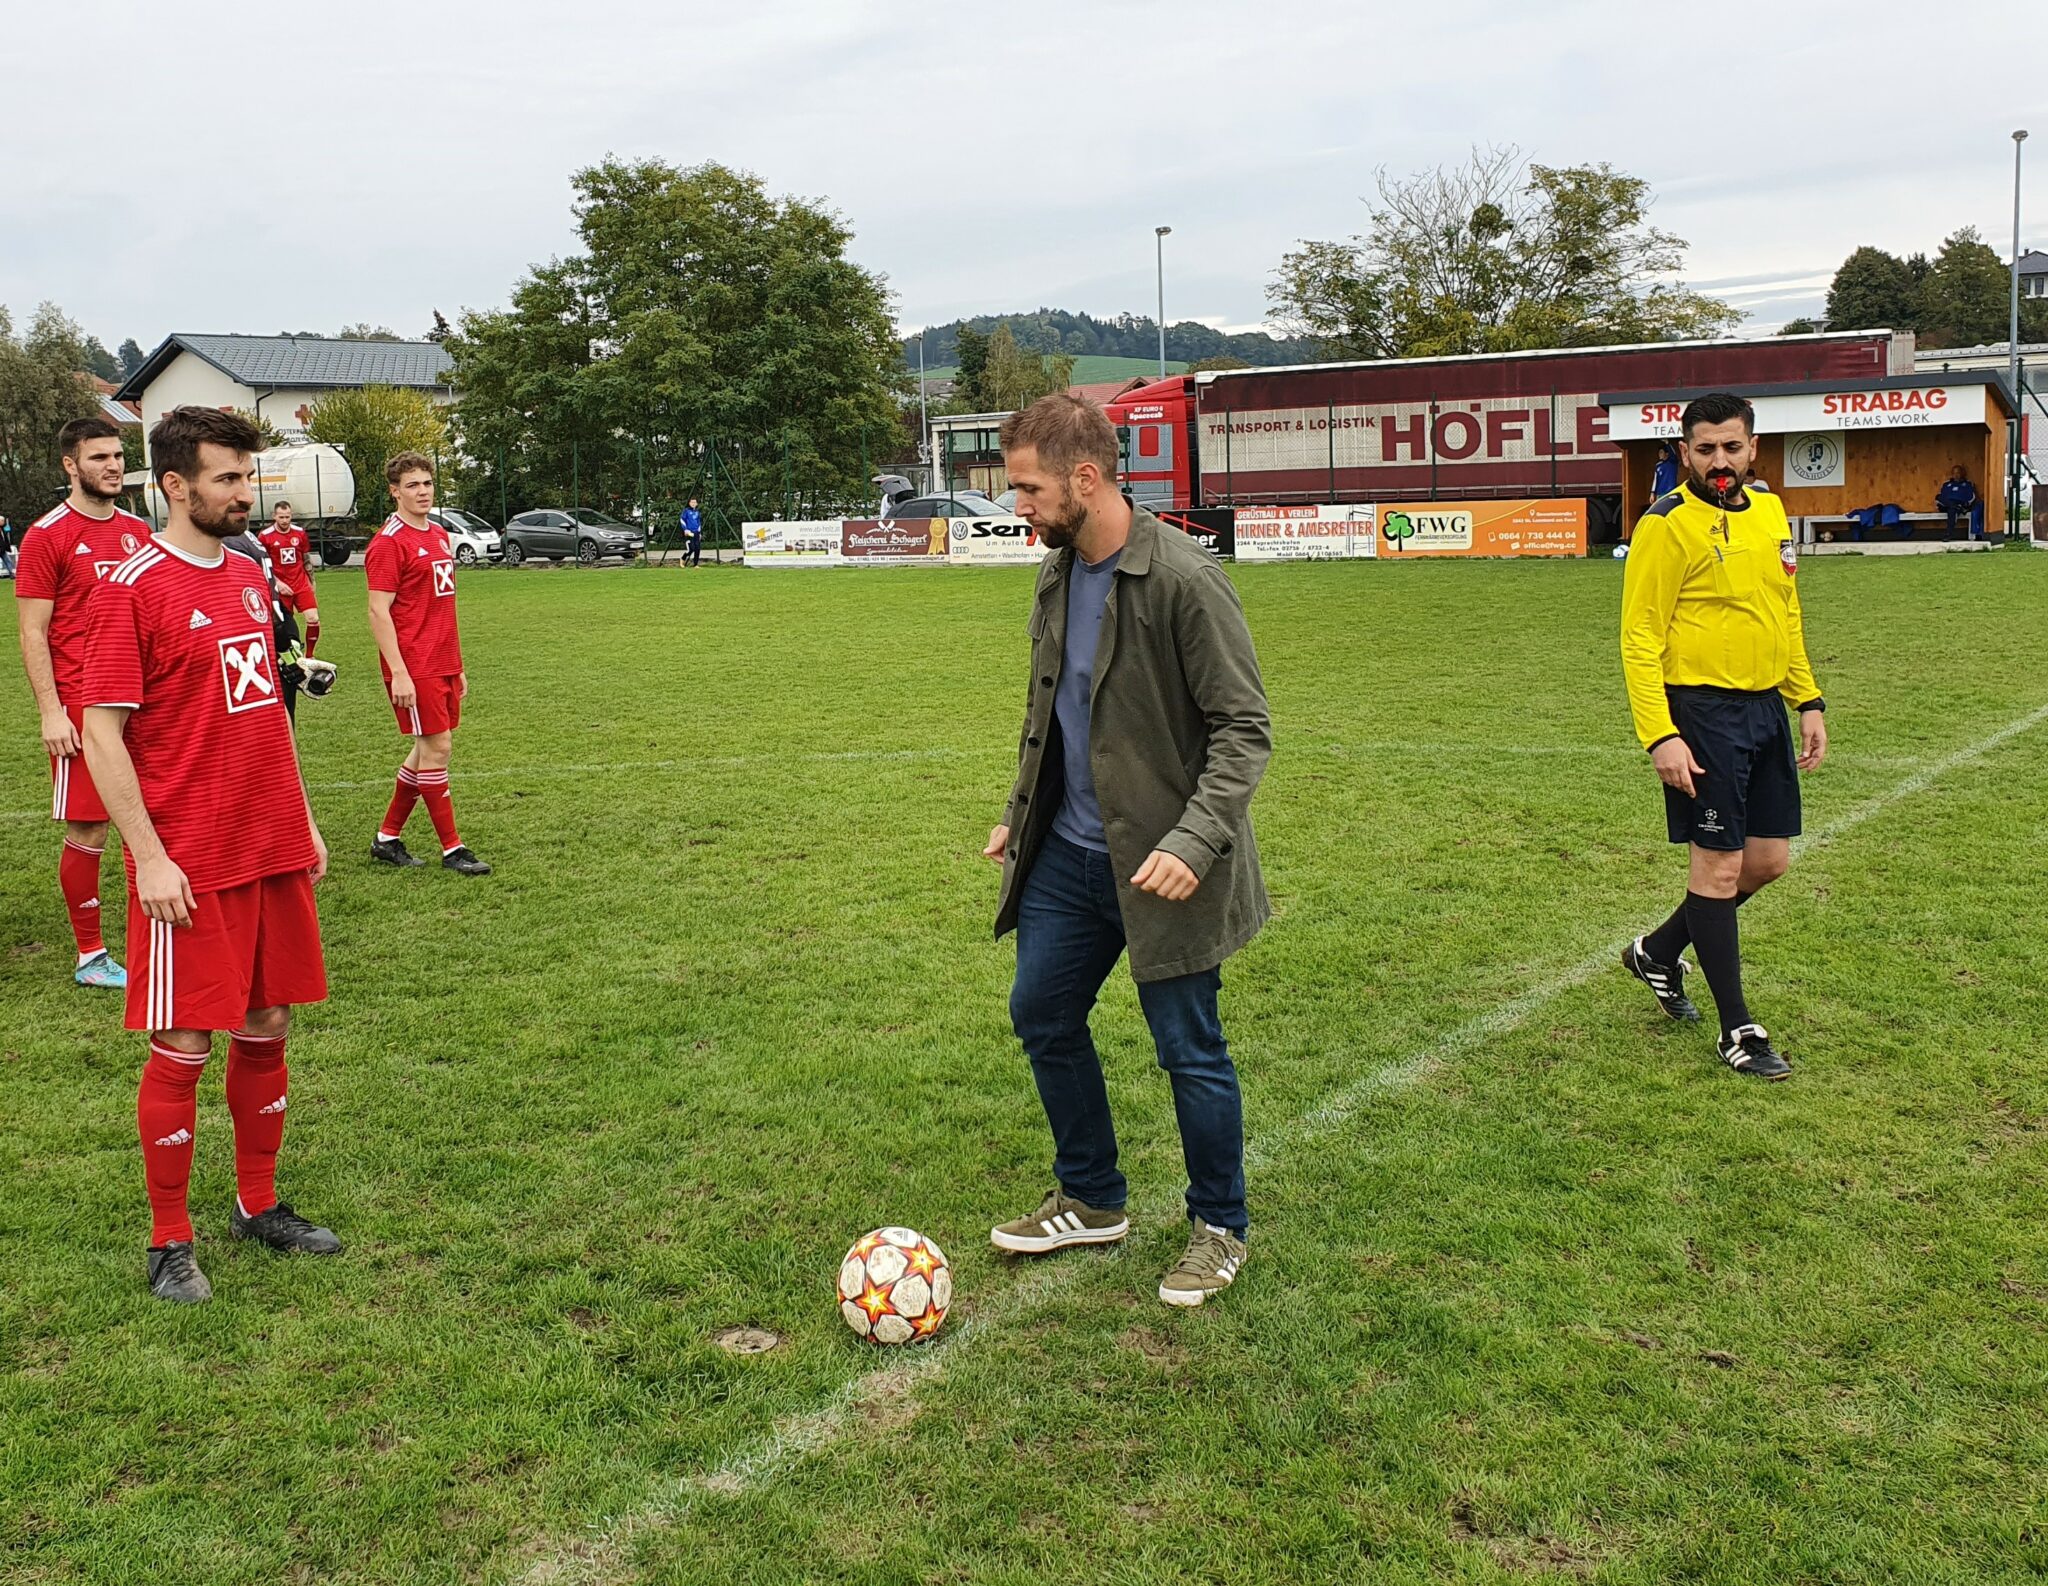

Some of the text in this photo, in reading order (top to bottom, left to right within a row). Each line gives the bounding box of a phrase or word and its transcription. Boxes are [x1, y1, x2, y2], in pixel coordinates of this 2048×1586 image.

[1823, 388, 1948, 415] STRABAG
[1129, 412, 1164, 420] Spacecab
[1837, 413, 1934, 427] TEAMS WORK.
[1209, 416, 1375, 435] TRANSPORT & LOGISTIK
[1236, 508, 1317, 519] GERÜSTBAU & VERLEIH
[1236, 520, 1374, 539] HIRNER & AMESREITER
[1416, 516, 1466, 533] FWG
[848, 533, 888, 548] Fleischerei
